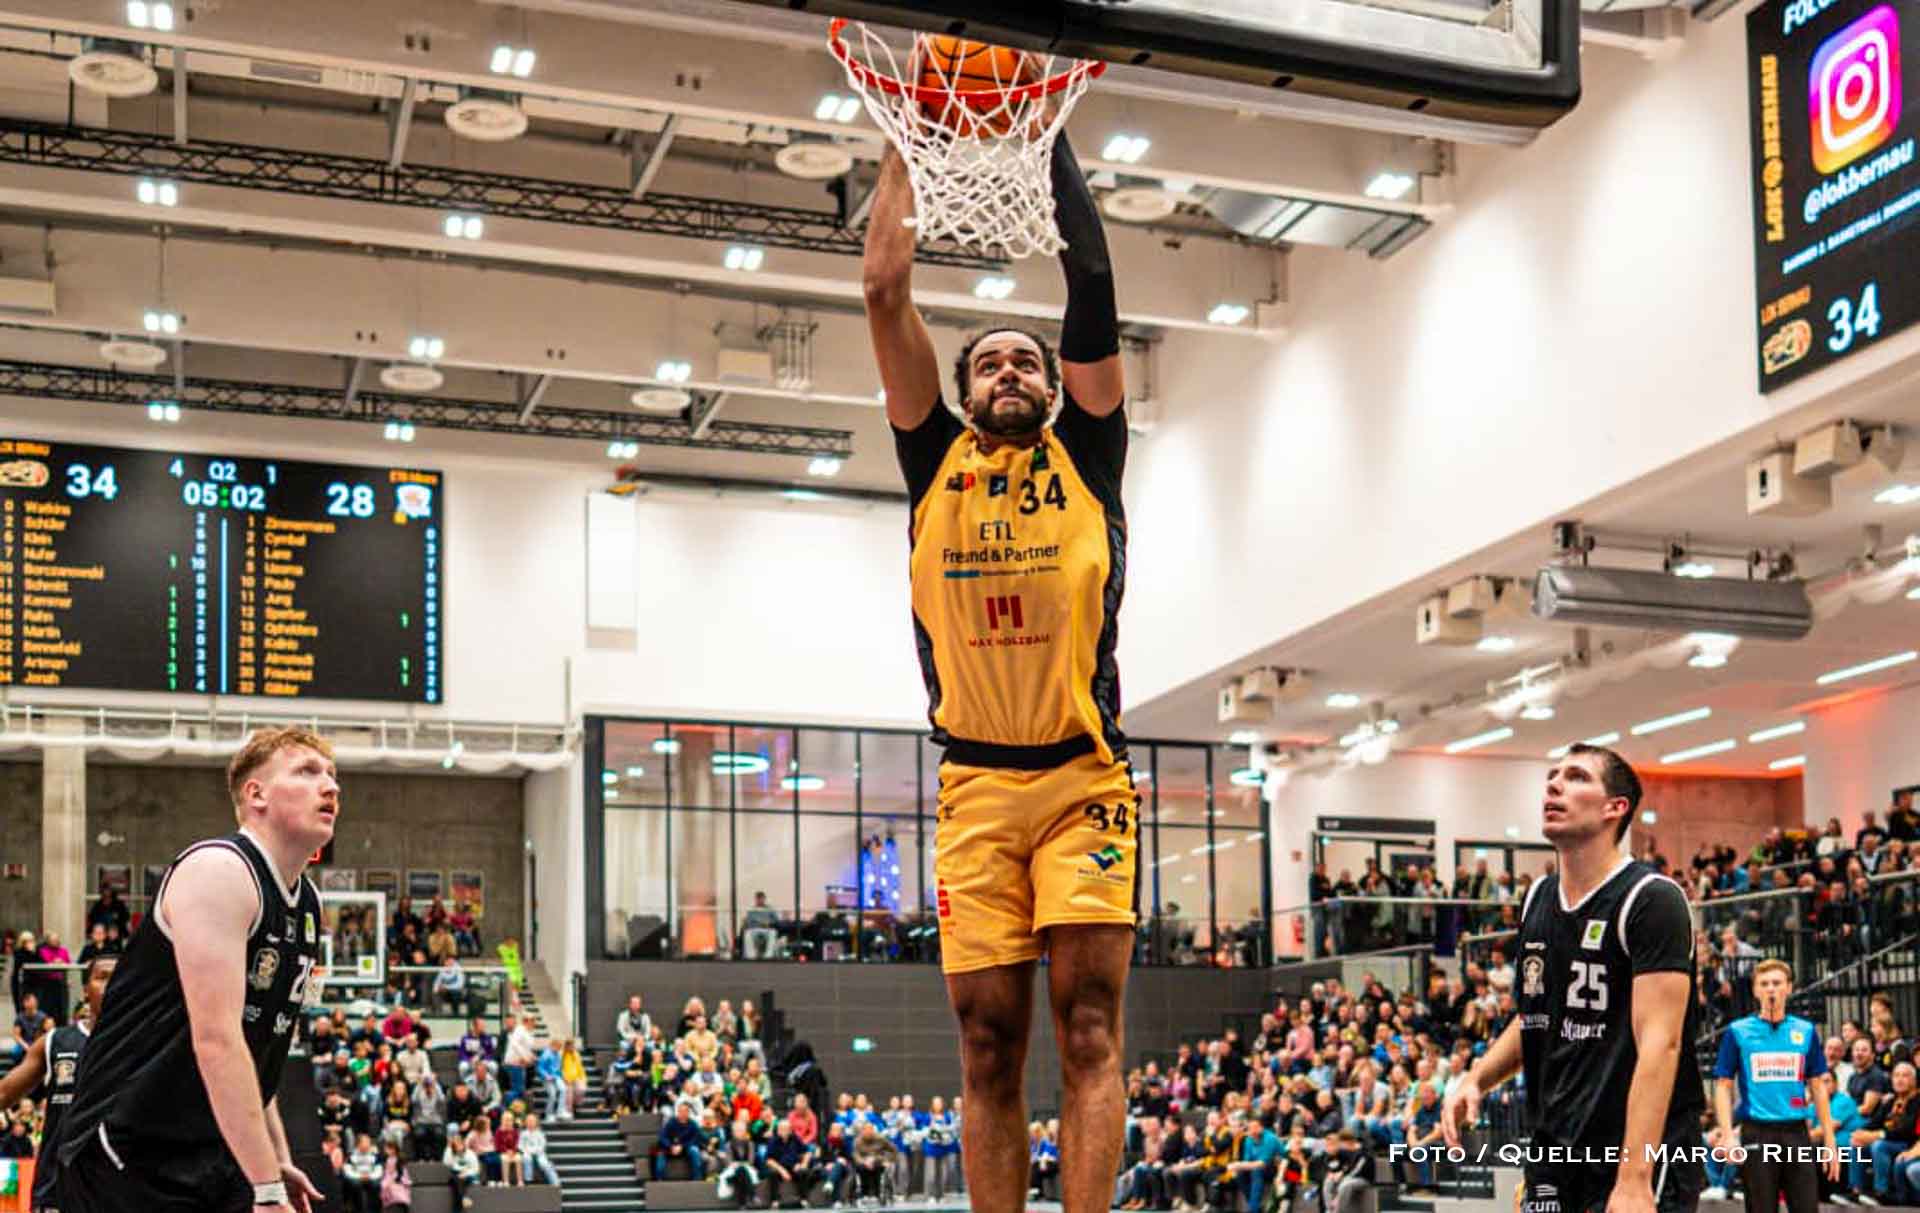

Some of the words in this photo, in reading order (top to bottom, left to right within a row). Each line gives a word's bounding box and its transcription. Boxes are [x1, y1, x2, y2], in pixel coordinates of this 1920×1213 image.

[1804, 138, 1915, 223] @lokbernau
[1827, 282, 1881, 353] 34
[66, 463, 118, 500] 34
[169, 459, 184, 478] 4
[208, 462, 237, 482] Q2
[266, 465, 277, 485] 1
[183, 482, 266, 511] 05:02
[326, 483, 375, 516] 28
[1019, 474, 1067, 516] 34
[980, 521, 1017, 541] ETL
[1005, 544, 1060, 563] Partner
[1085, 801, 1129, 835] 34
[1566, 960, 1609, 1012] 25
